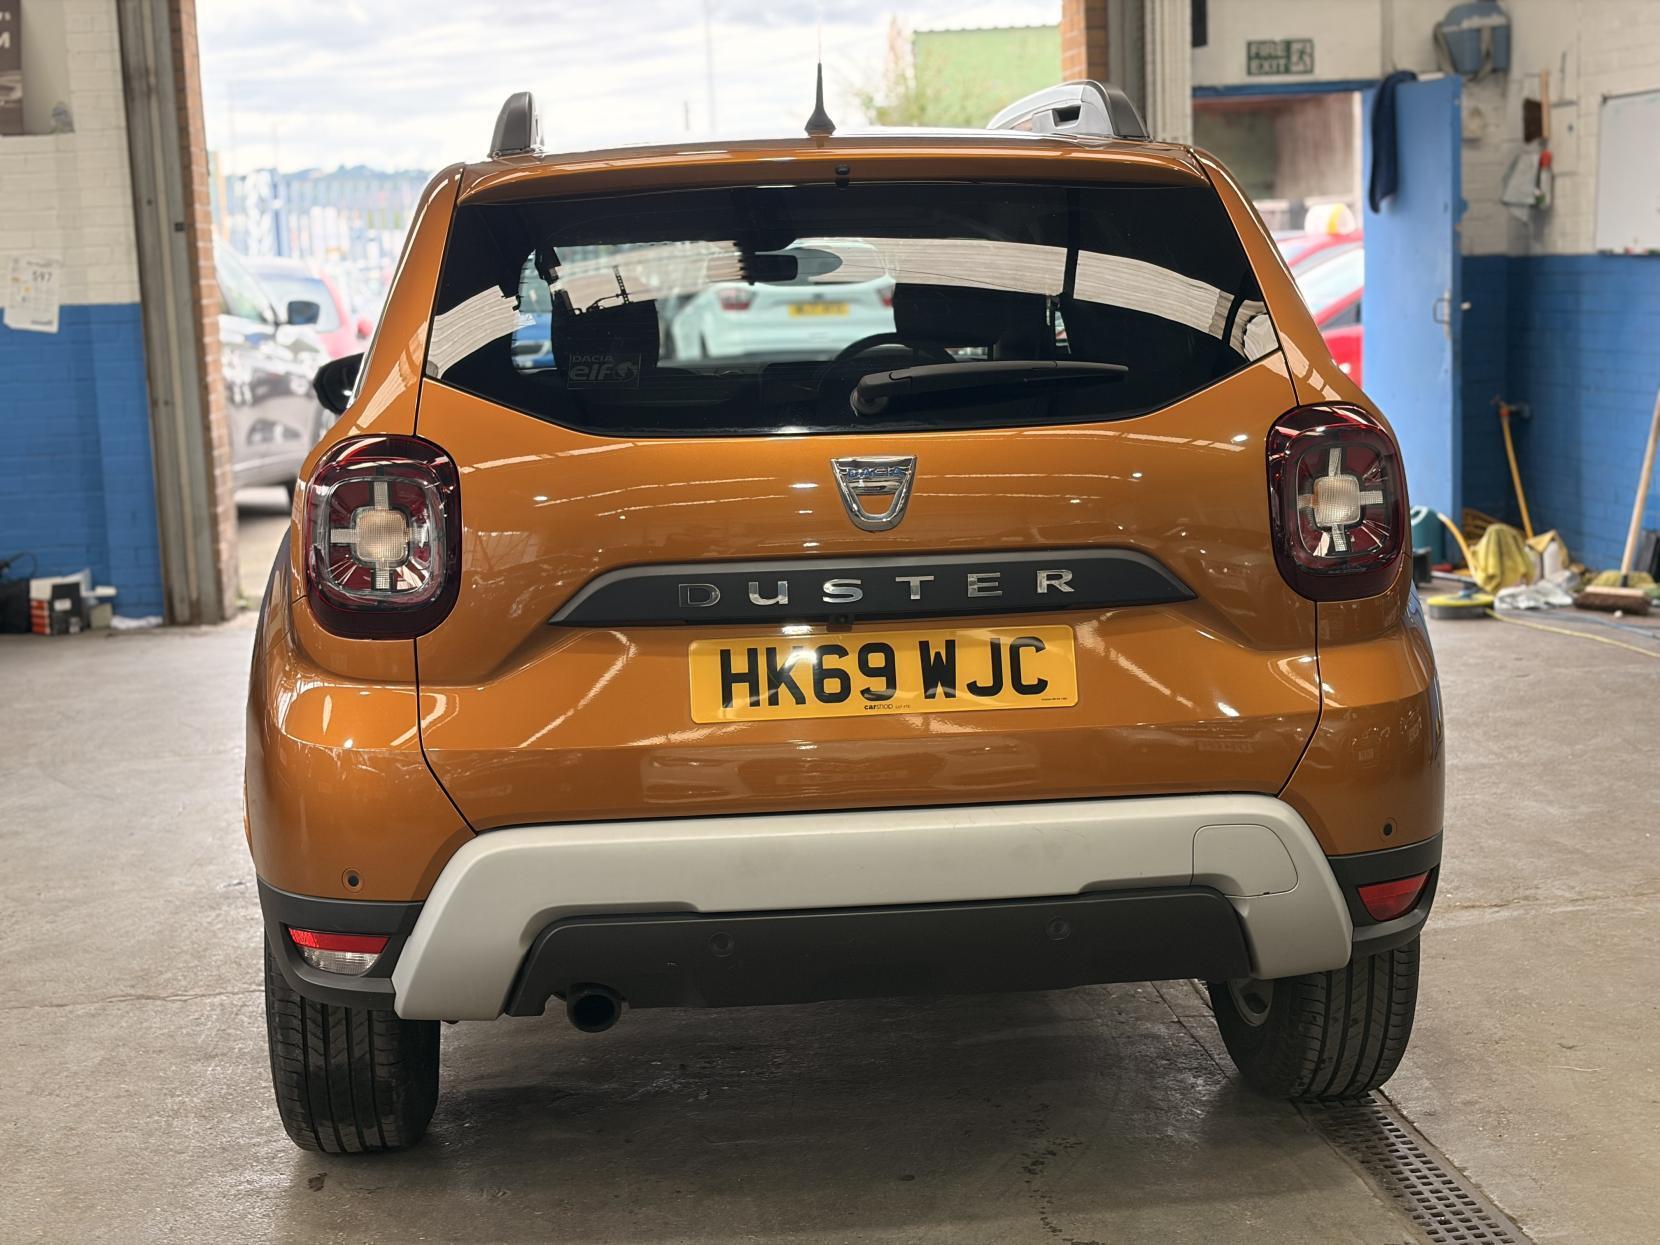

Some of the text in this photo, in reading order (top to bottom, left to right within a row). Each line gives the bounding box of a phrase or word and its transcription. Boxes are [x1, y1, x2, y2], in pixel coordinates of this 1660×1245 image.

[1249, 42, 1286, 57] FIRE
[1249, 59, 1286, 73] EXIT
[572, 354, 615, 363] DACIA
[678, 569, 1075, 608] DUSTER
[719, 636, 1049, 709] HK69 WJC
